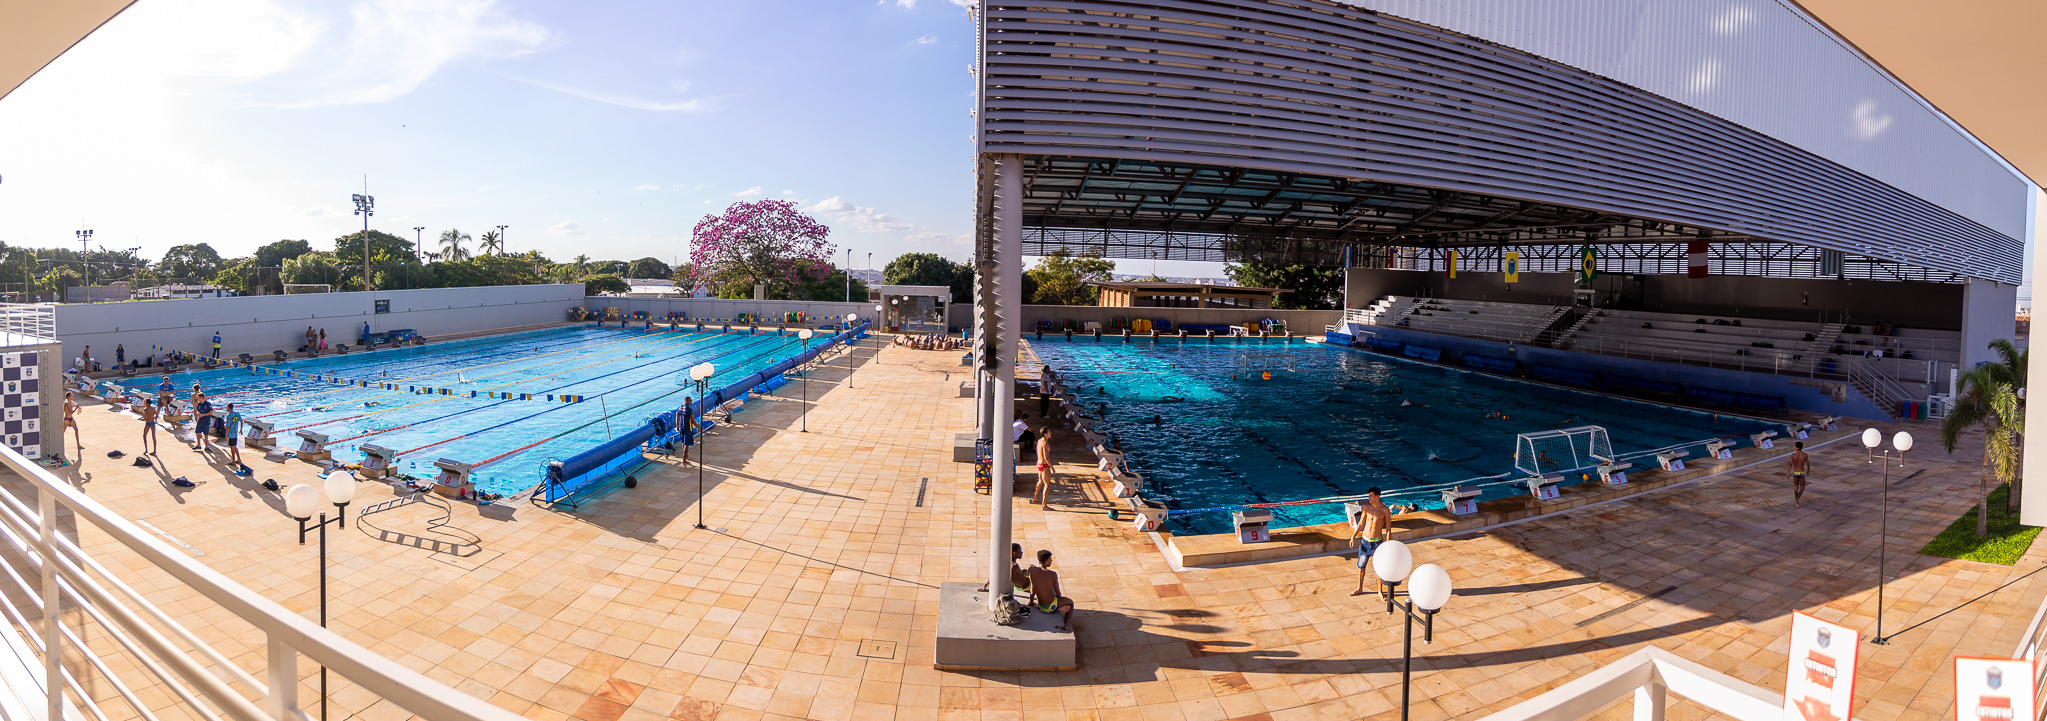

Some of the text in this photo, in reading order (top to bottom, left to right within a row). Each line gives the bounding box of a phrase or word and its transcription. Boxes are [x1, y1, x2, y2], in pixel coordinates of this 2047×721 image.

[317, 444, 322, 452] 2
[384, 460, 388, 468] 1
[445, 475, 452, 484] 0
[460, 475, 466, 484] 0
[1604, 475, 1608, 483] 5
[1126, 488, 1130, 496] 1
[1534, 488, 1538, 496] 6
[1546, 490, 1552, 498] 6
[1448, 502, 1452, 511] 7
[1463, 504, 1468, 512] 7
[1148, 520, 1154, 530] 0
[1250, 530, 1258, 540] 9
